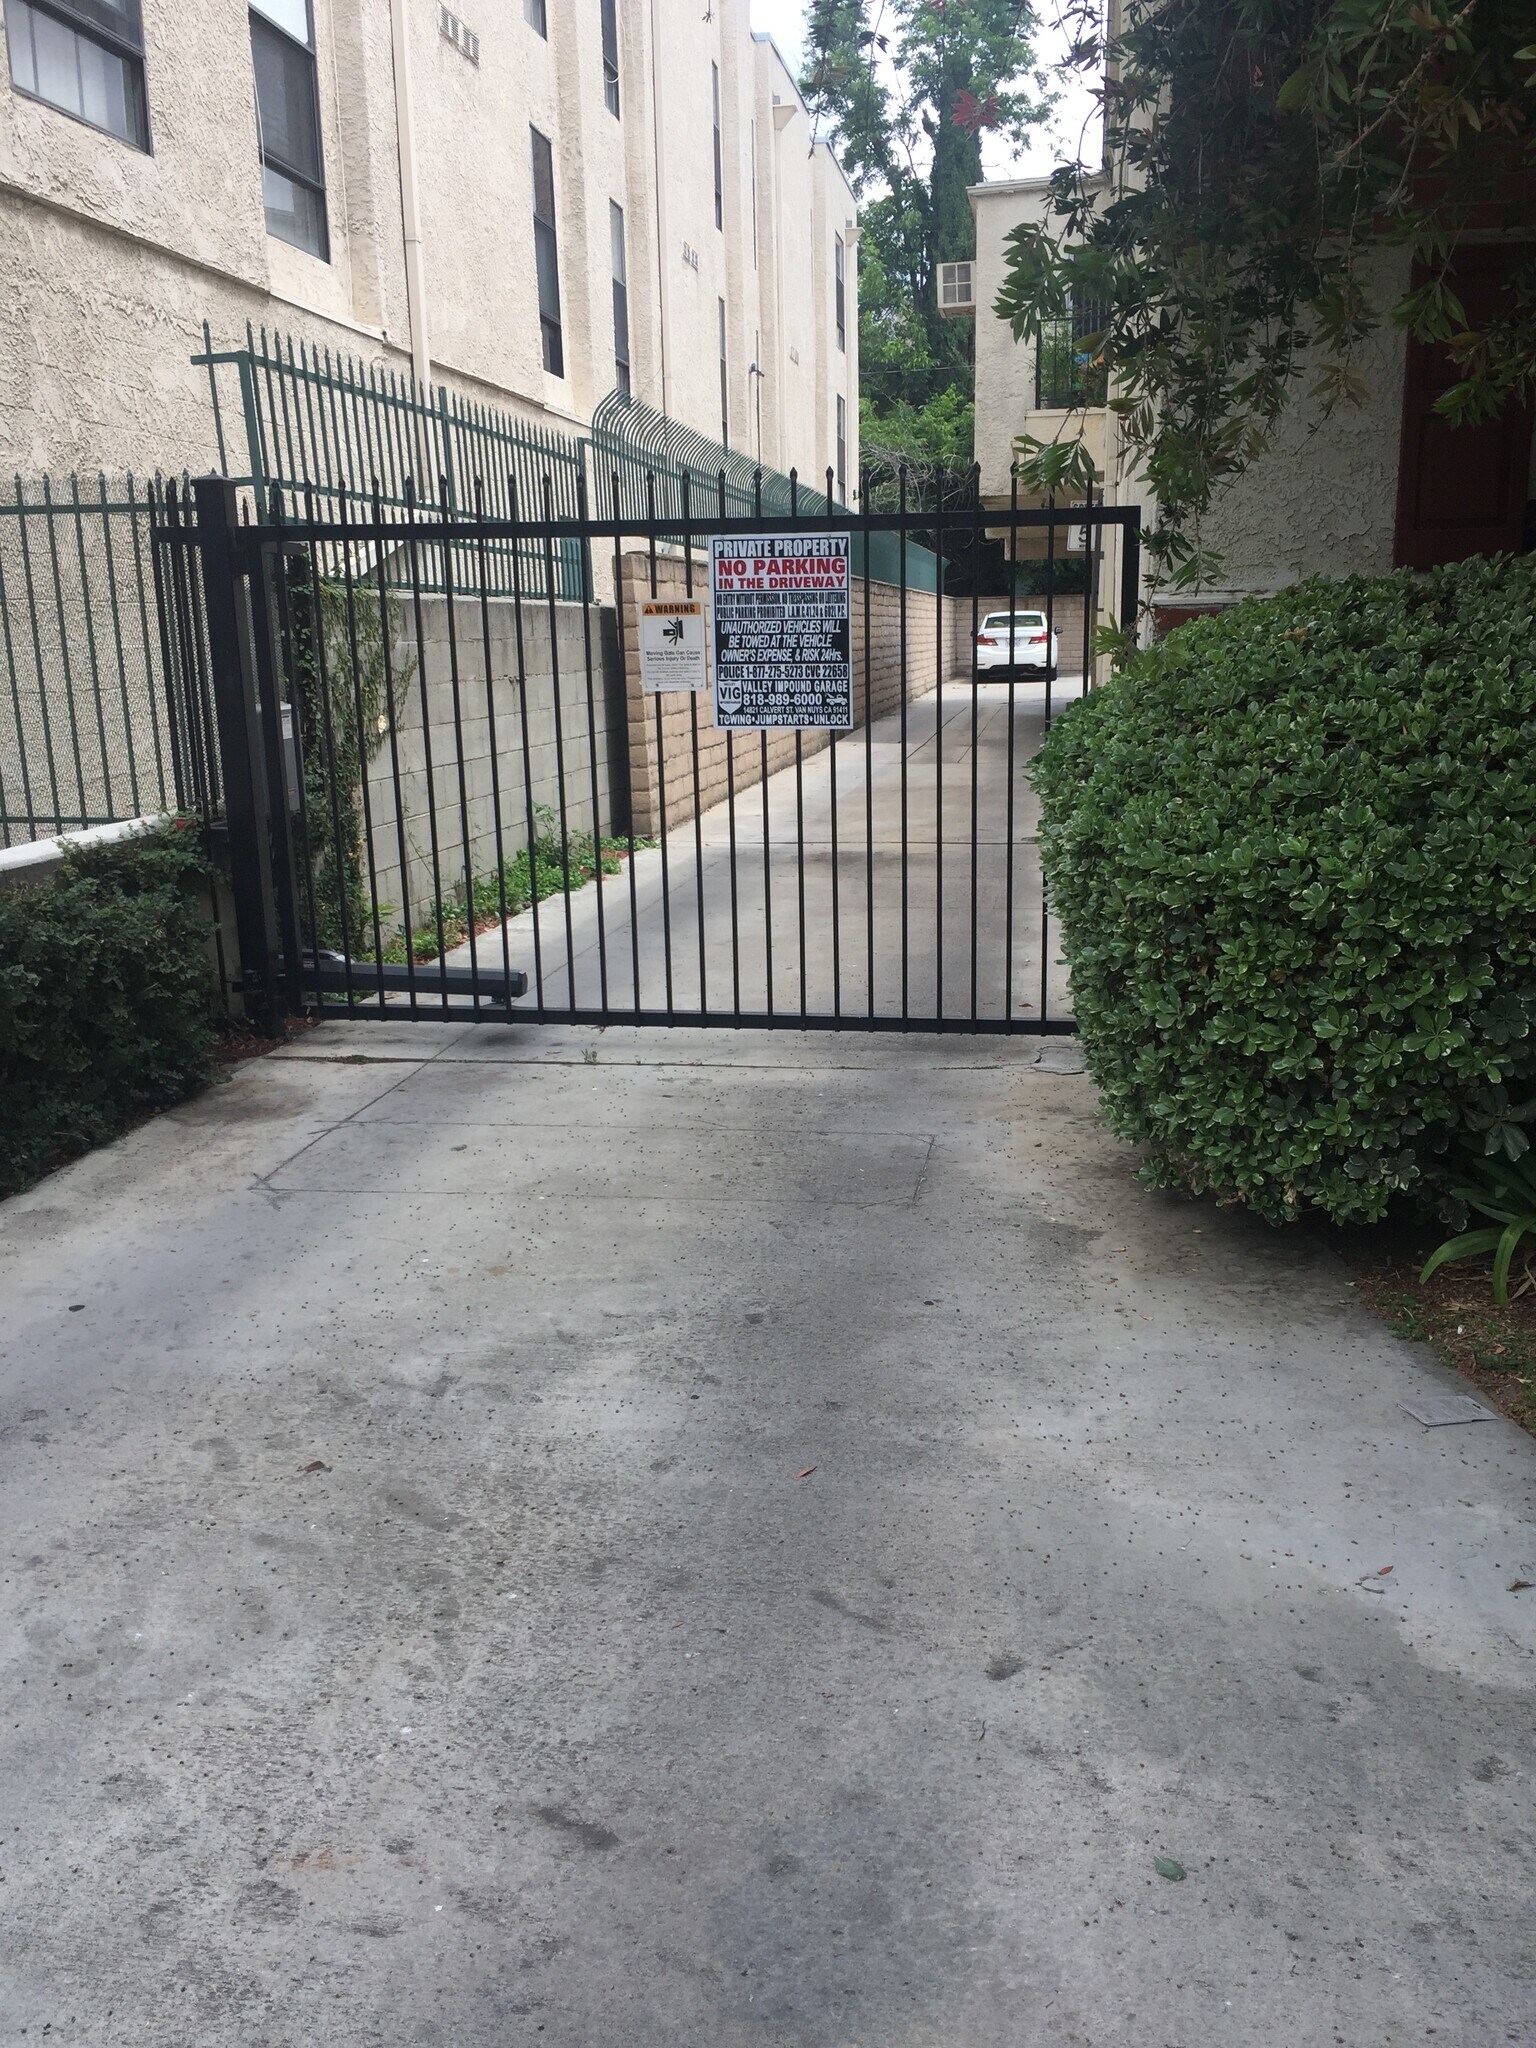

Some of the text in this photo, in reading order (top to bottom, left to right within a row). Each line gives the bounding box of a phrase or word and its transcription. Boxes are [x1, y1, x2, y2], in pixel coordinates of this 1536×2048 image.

[715, 539, 846, 557] PRIVATE PROPERTY
[719, 558, 845, 576] NO PARKING
[719, 576, 845, 589] IN THE DRIVEWAY
[655, 605, 695, 613] WARNING
[717, 607, 734, 619] PUBLIC
[735, 607, 756, 618] PARKING
[757, 606, 785, 618] PROHIBITED
[721, 620, 841, 634] UNAUTHORIZED VEHICLES WILL
[729, 635, 832, 648] BE TOWED AT THE VEHICLE
[721, 649, 756, 662] OWNER'S
[757, 649, 792, 662] EXPENSE,
[795, 650, 800, 661] &
[802, 649, 819, 661] RISK
[719, 665, 847, 678] POLICE 1-877-275-5273 CVC 22658
[720, 687, 740, 699] VIG
[743, 681, 847, 692] VALLEY IMPOUND GARAGE
[743, 694, 822, 705] 818-989-6000
